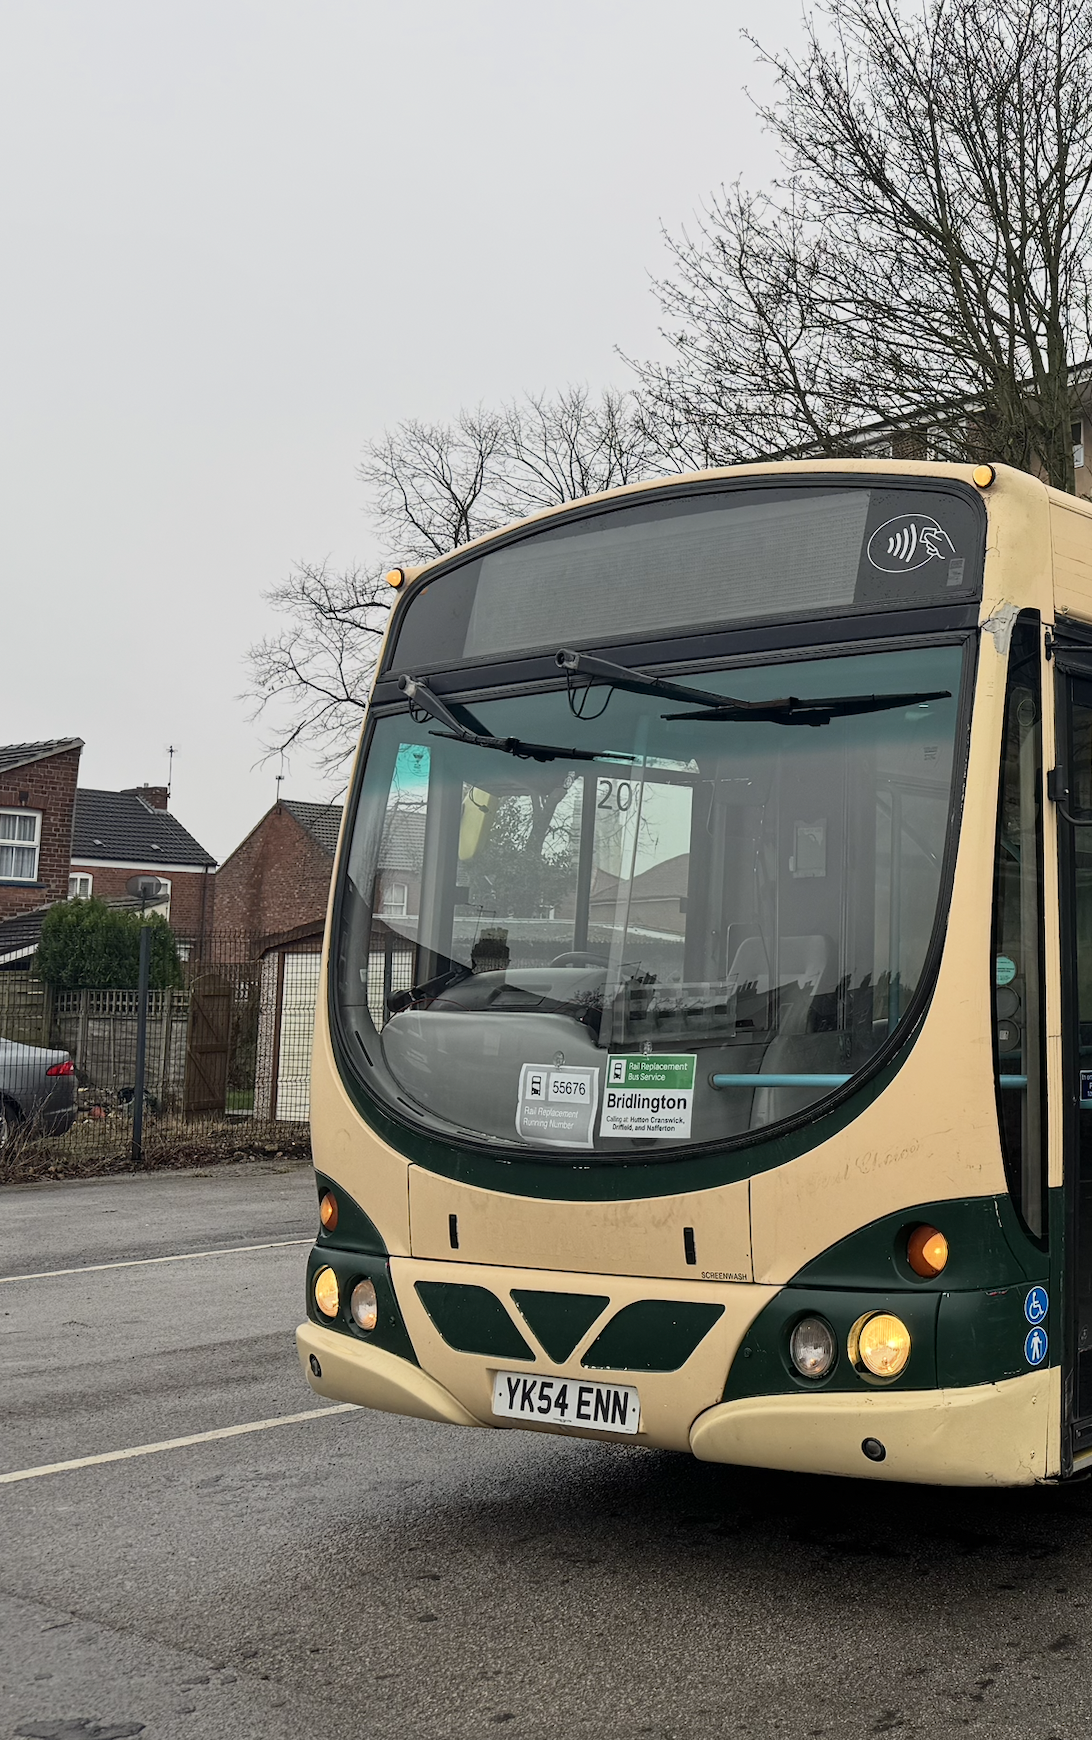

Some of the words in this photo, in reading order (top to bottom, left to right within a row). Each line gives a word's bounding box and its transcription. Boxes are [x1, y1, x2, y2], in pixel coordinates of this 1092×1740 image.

[628, 1062, 640, 1071] Rail
[641, 1062, 688, 1071] Replacement
[640, 1073, 666, 1081] Service
[552, 1081, 586, 1096] 55676
[607, 1093, 687, 1113] Bridlington
[524, 1106, 536, 1115] Rail
[537, 1107, 578, 1118] Replacement
[523, 1117, 548, 1129] Running
[549, 1119, 574, 1130] Number
[606, 1115, 622, 1123] Calling
[635, 1123, 646, 1131] and
[647, 1124, 676, 1132] Nafferton
[701, 1271, 748, 1280] SCREENWASH
[506, 1376, 569, 1417] YK54
[576, 1386, 629, 1425] ENN
